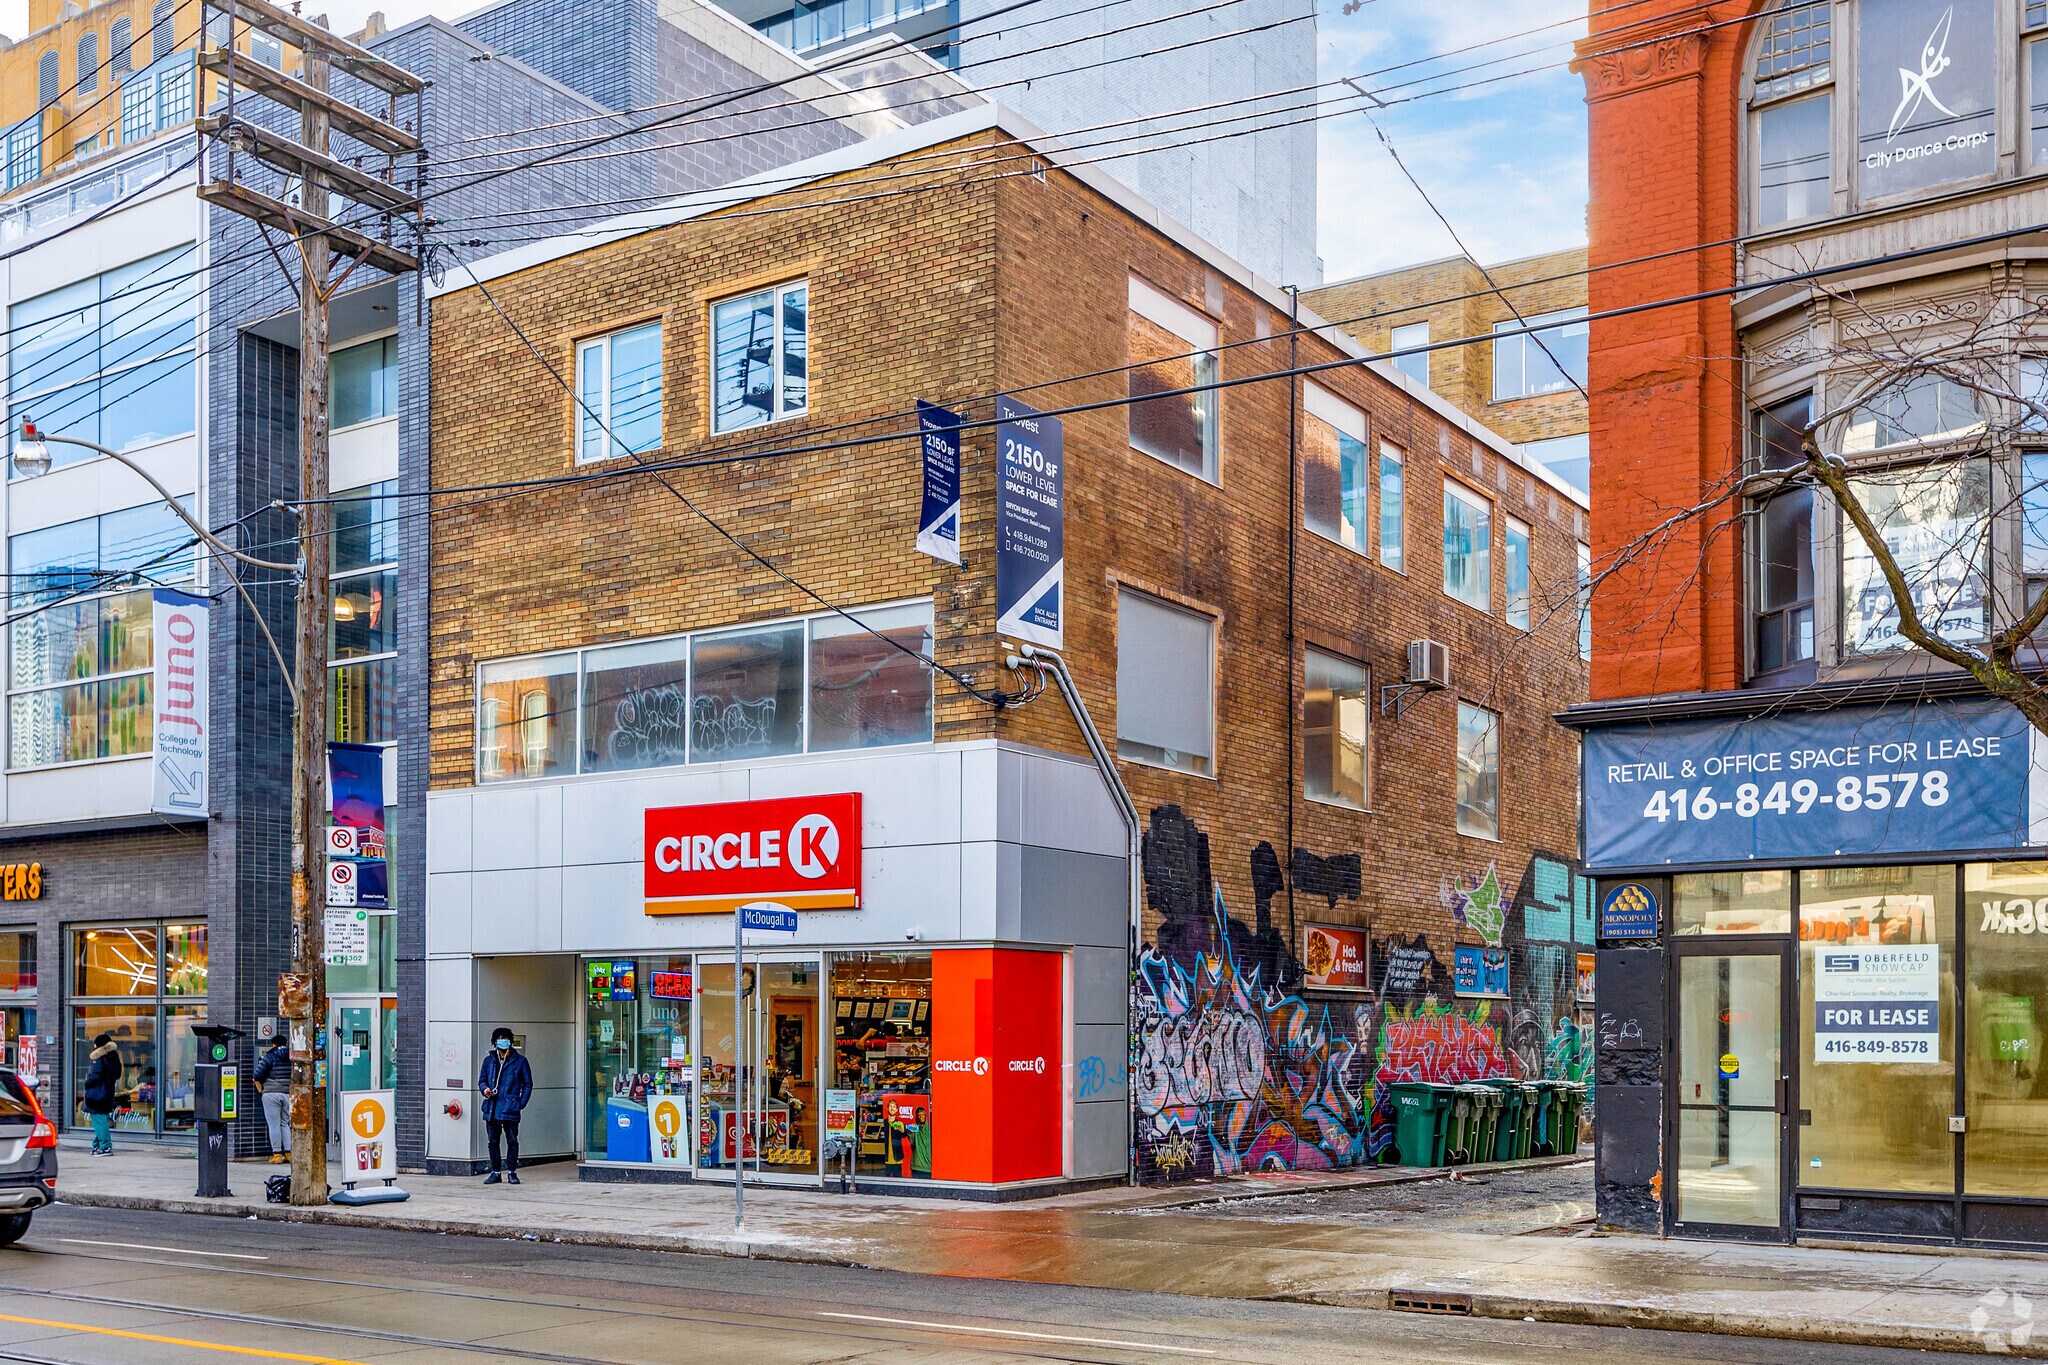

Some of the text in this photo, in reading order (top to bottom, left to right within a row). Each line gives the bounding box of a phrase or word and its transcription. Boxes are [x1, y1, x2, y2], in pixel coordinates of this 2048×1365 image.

[1866, 130, 1988, 168] City Dance Corps
[1006, 439, 1057, 478] 2,150 SF
[1006, 465, 1057, 495] LOWER LEVEL
[1006, 480, 1057, 508] SPACE FOR LEASE
[1013, 530, 1047, 549] 416.941.1289
[1035, 607, 1058, 620] BACK ALLEY
[1035, 615, 1057, 628] ENTRANCE
[159, 614, 203, 735] Juno
[159, 733, 198, 746] College of
[159, 744, 203, 758] Technology
[1607, 737, 2001, 784] RETAIL & OFFICE SPACE FOR LEASE
[1642, 770, 1950, 822] 416-849-8578
[654, 823, 837, 876] CIRCLE K
[745, 911, 795, 926] McDougall Ln
[1605, 914, 1654, 922] MONOPOLY
[1342, 944, 1356, 958] Hot
[1864, 953, 1929, 963] OBERFELD
[1335, 959, 1363, 973] & fresh!
[1865, 963, 1924, 972] SNOWCAP
[654, 973, 691, 987] OPEN
[654, 986, 691, 998] 24 HOURS
[647, 1004, 679, 1023] Juno
[1824, 1009, 1929, 1025] FOR LEASE
[1825, 1040, 1928, 1054] 416-849-8578
[935, 1059, 987, 1075] CIRCLE K
[1009, 1059, 1044, 1074] CIRCLE K
[112, 1105, 149, 1128] Outfitters
[357, 1111, 374, 1134] $1
[659, 1113, 672, 1133] $1
